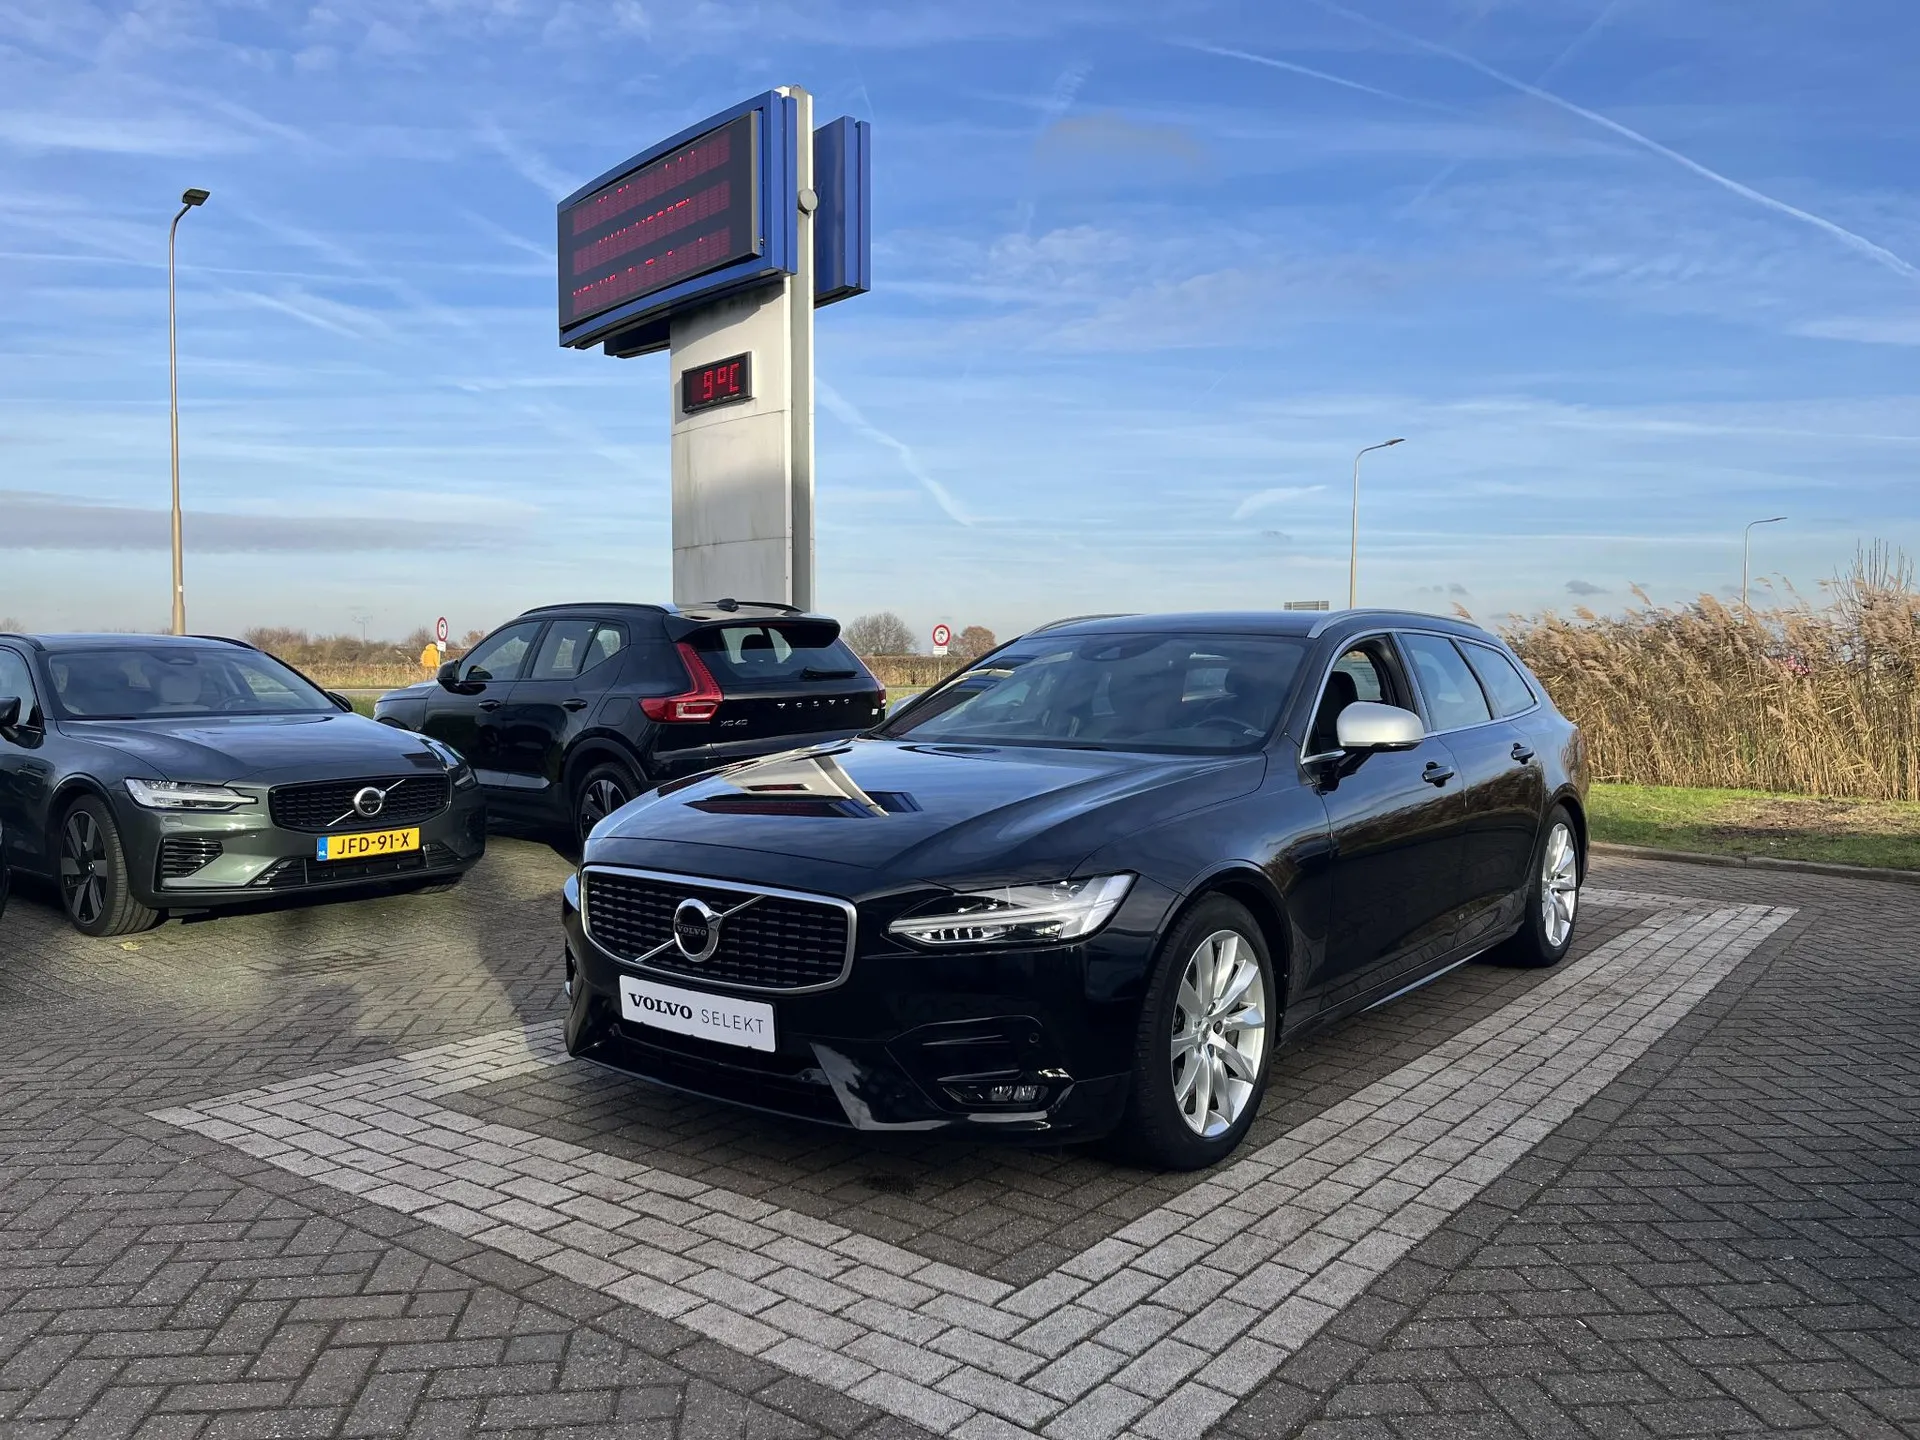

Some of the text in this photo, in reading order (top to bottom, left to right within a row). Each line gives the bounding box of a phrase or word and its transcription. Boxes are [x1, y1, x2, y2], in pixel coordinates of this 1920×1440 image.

[337, 832, 410, 855] JFD-91-X
[676, 925, 707, 936] VOLVO
[628, 992, 764, 1034] VOLVO SELEKT
